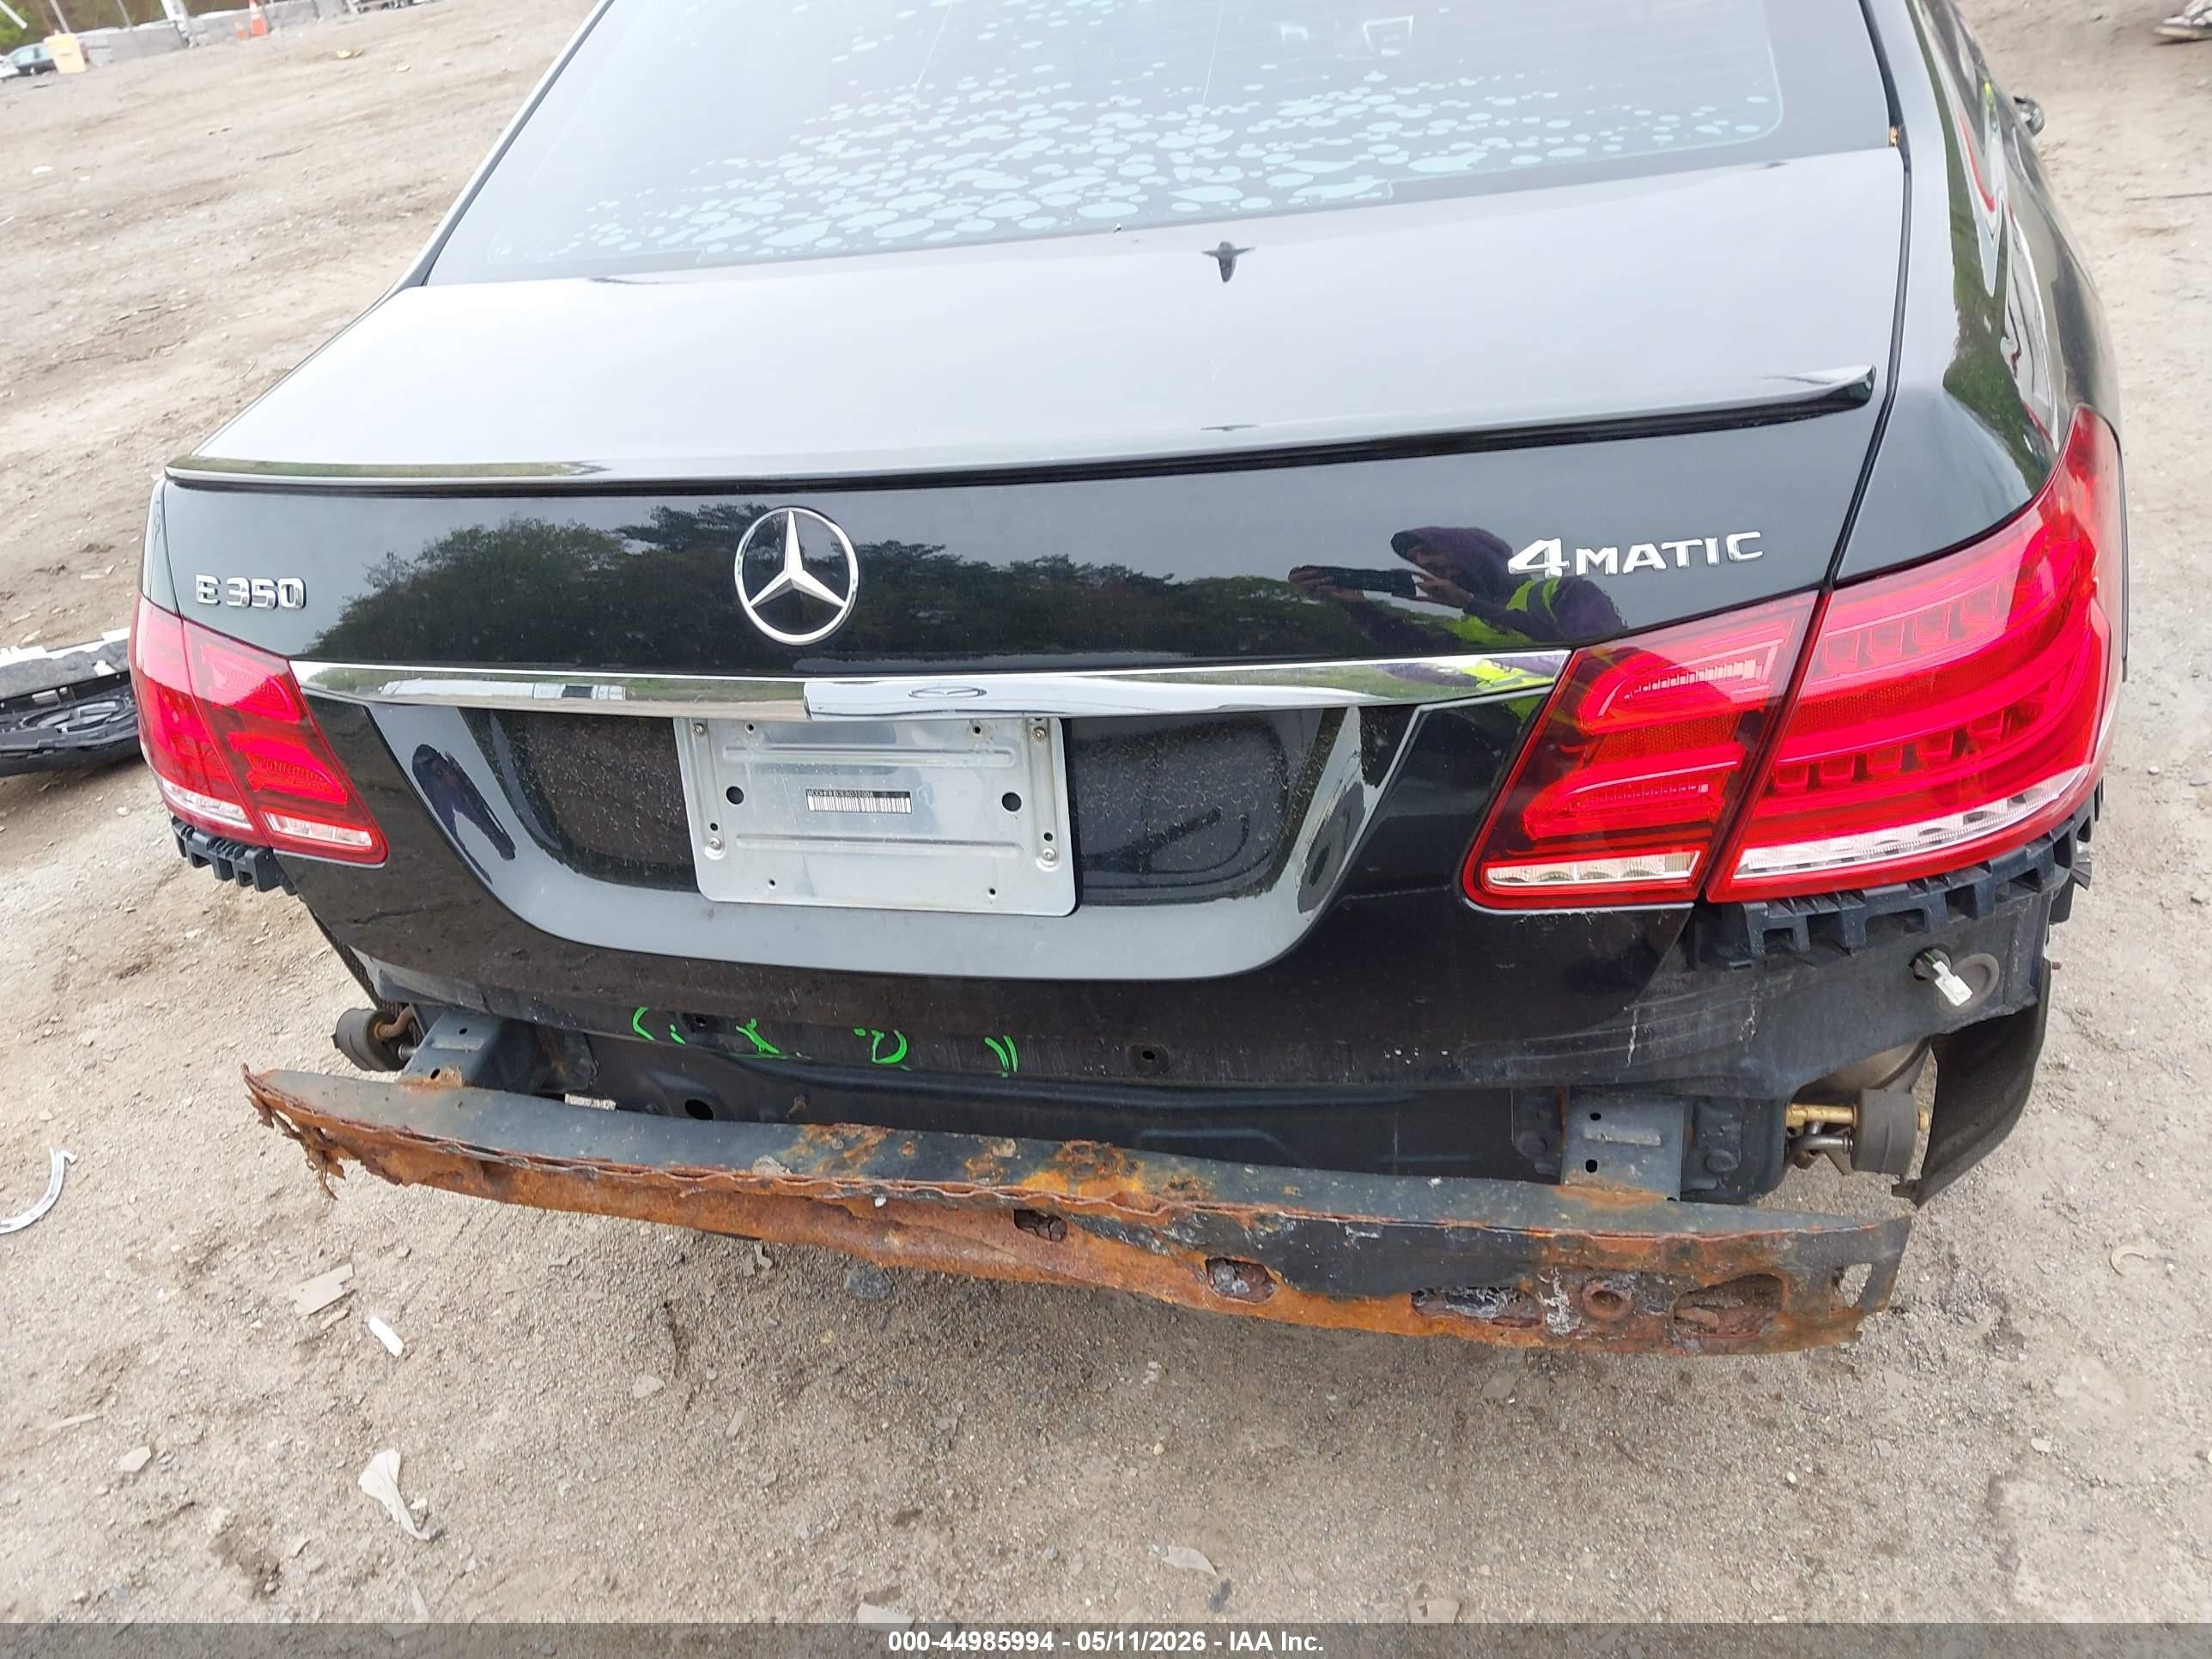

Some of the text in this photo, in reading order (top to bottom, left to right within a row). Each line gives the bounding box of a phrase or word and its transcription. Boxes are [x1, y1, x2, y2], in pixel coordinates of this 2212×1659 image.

[1507, 531, 1764, 578] 4MATIC
[195, 574, 307, 610] E 350
